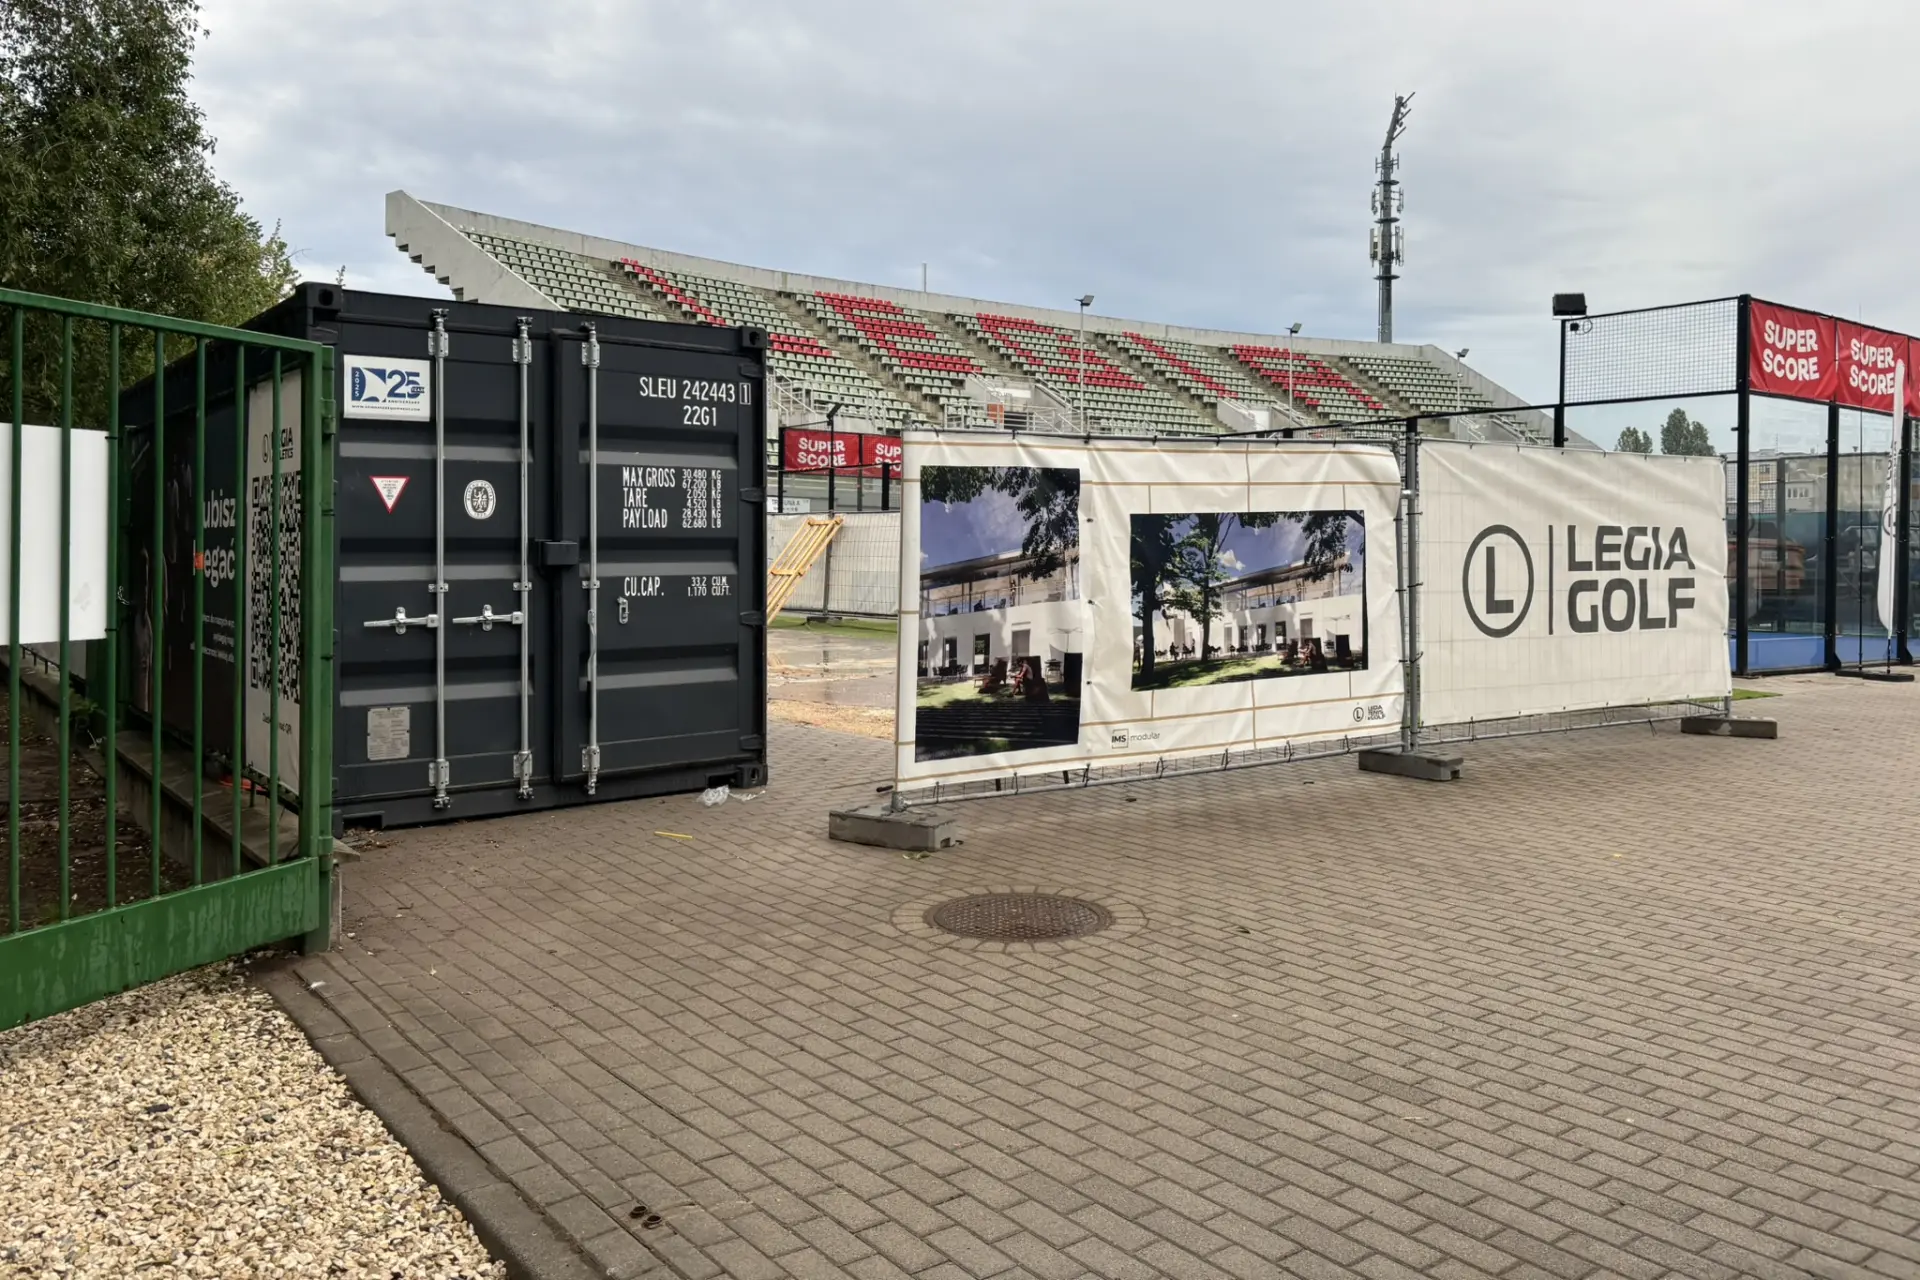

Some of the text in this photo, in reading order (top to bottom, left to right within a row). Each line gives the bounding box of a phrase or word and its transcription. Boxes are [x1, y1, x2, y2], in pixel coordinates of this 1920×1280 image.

[1764, 319, 1818, 353] SUPER
[1850, 338, 1895, 369] SUPER
[1762, 348, 1820, 381] SCORE
[386, 369, 421, 399] 25
[639, 376, 677, 399] SLEU
[682, 380, 736, 403] 242443
[1849, 364, 1895, 395] SCORE
[683, 405, 717, 427] 22G1
[798, 437, 846, 453] SUPER
[875, 443, 901, 458] SUP
[797, 451, 847, 468] SCORE
[622, 466, 676, 488] MAX GROSS
[682, 468, 722, 480] 30.480 KG
[682, 478, 722, 490] 67.200 LB
[623, 487, 648, 508] TARE
[686, 488, 722, 499] 2.050 KG
[686, 498, 722, 509] 4.520 LB
[203, 489, 236, 529] ubisz
[622, 507, 668, 528] PAYLOAD
[682, 508, 722, 519] 28.430 KG
[682, 518, 722, 529] 62.680 LB
[1567, 524, 1696, 572] LEGIA
[624, 576, 665, 597] CU.CAP.
[691, 576, 707, 587] 33.2
[1485, 546, 1514, 614] L
[687, 586, 707, 597] 1.170
[1567, 577, 1695, 633] GOLF
[1111, 731, 1161, 744] IMS modular
